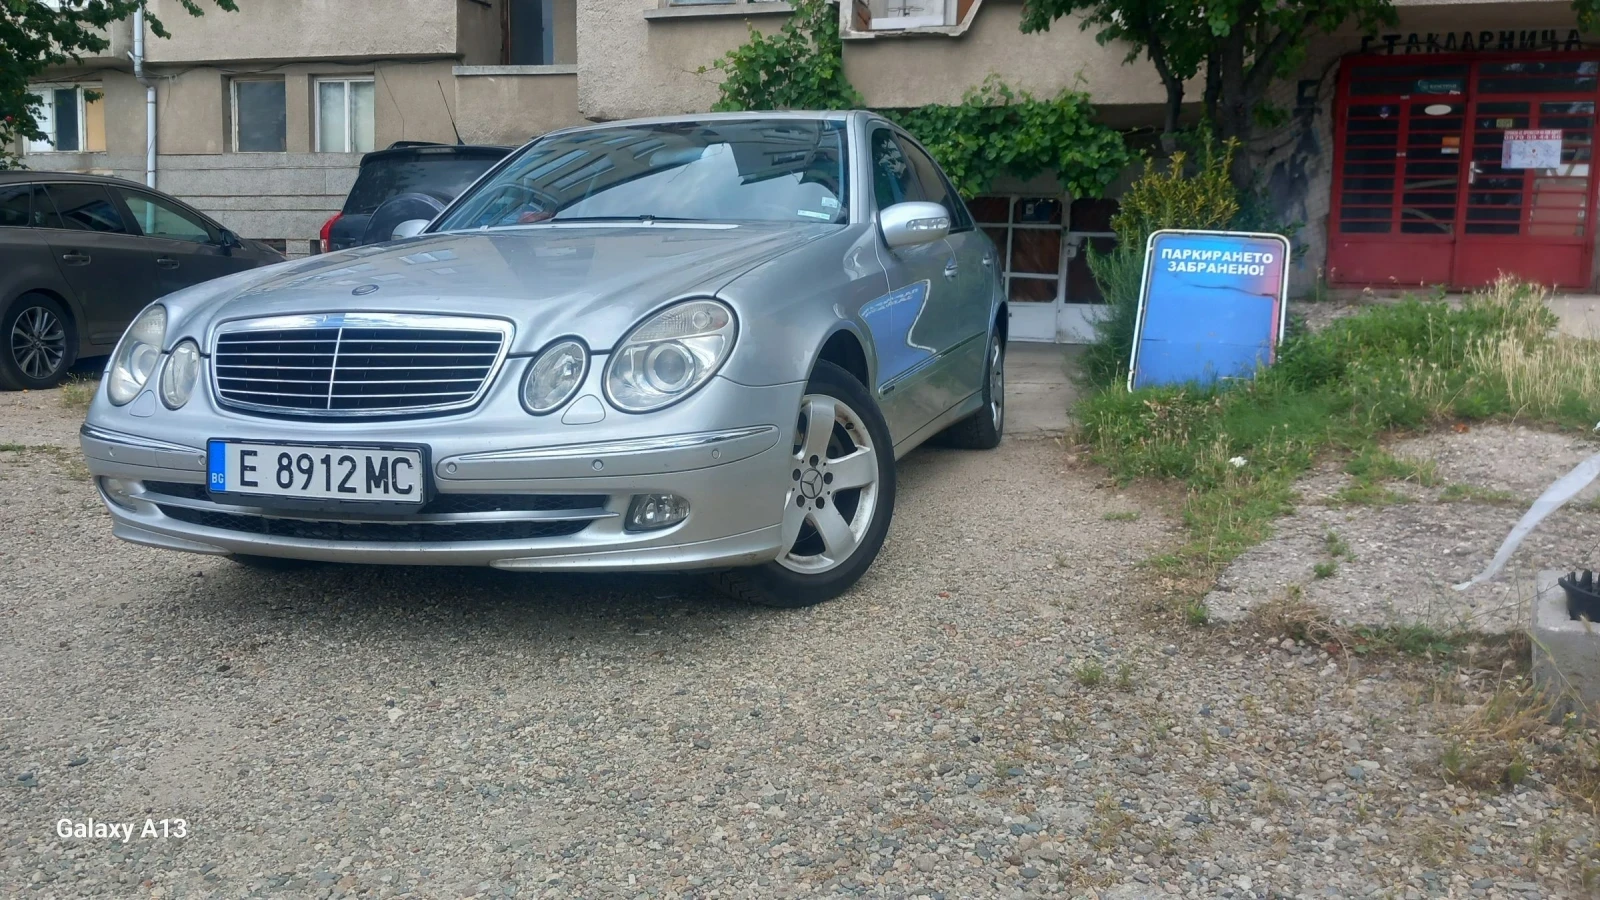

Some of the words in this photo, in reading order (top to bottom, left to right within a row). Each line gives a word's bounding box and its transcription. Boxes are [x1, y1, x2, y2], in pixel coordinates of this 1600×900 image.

[1161, 248, 1274, 264] ПАРКИРАНЕТО
[1167, 261, 1265, 276] ЗАБРАНЕНО!
[239, 449, 259, 487] E
[211, 472, 225, 484] BG
